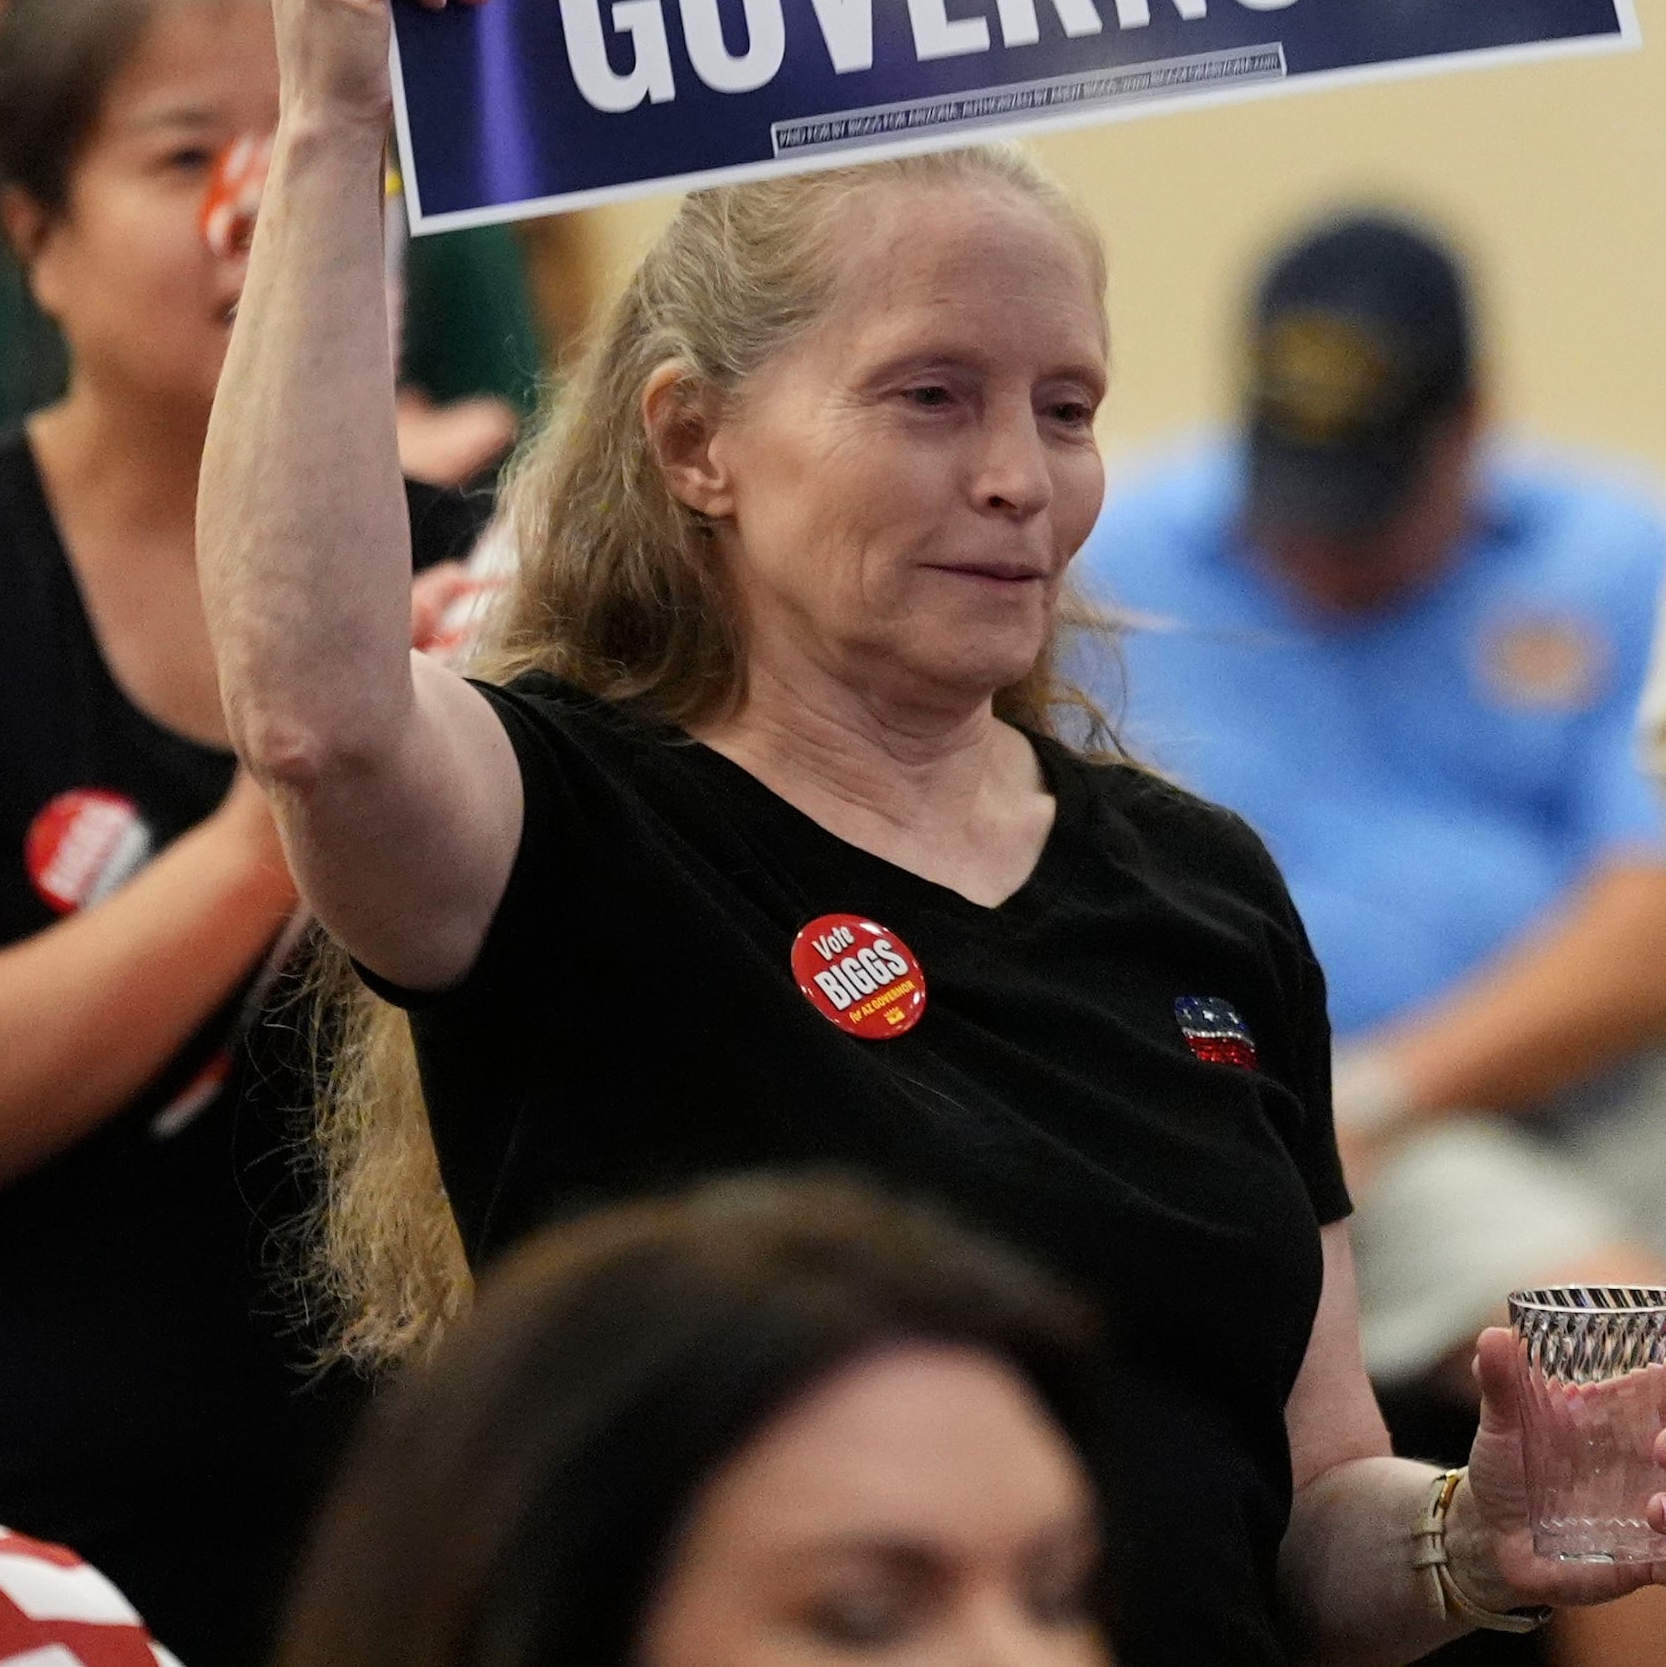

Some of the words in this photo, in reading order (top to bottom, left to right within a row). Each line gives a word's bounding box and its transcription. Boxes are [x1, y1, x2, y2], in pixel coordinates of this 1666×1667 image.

[812, 925, 855, 961] Vote
[813, 939, 909, 1011] BIGGS
[861, 1003, 876, 1016] AZ
[871, 980, 916, 1010] GOVERNOR
